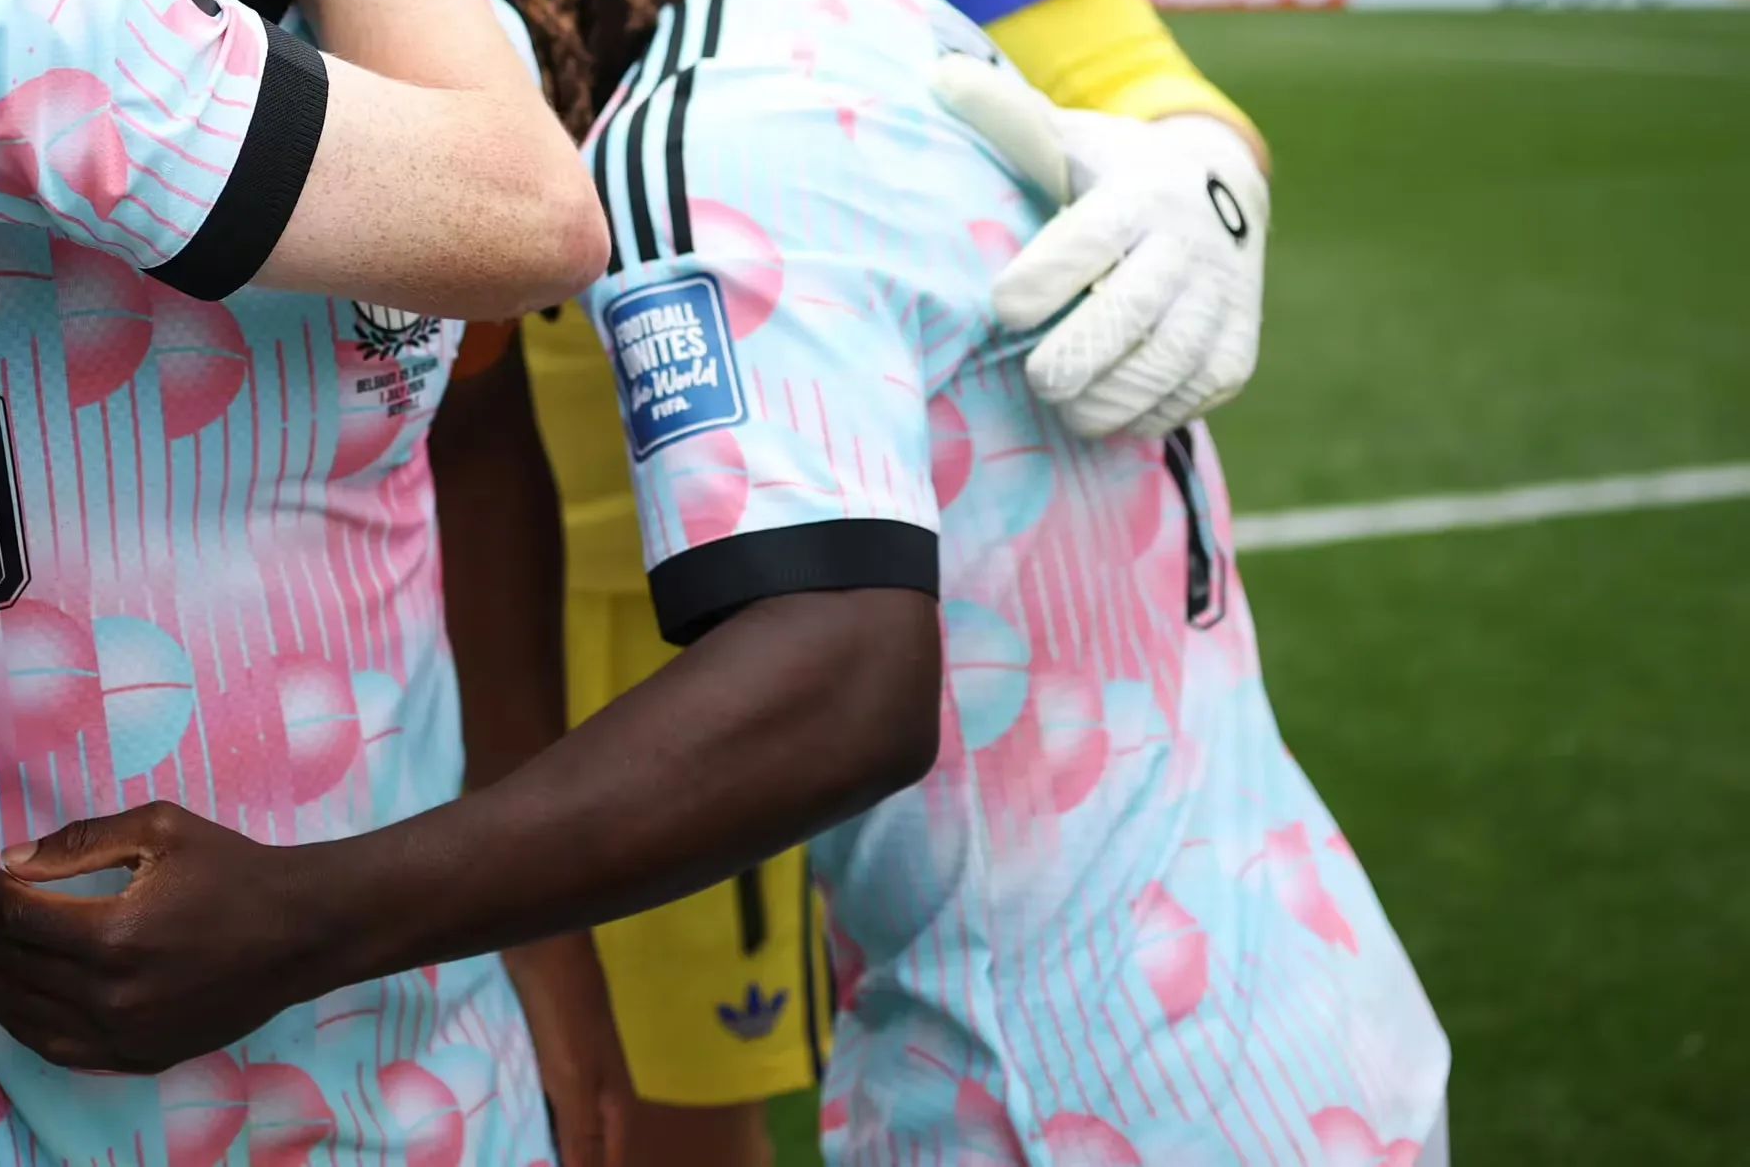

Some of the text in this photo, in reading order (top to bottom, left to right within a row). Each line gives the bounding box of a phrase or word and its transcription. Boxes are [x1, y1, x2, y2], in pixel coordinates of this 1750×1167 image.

[614, 301, 701, 348] FOOTBALL
[619, 326, 707, 380] UNITES
[650, 356, 718, 399] World
